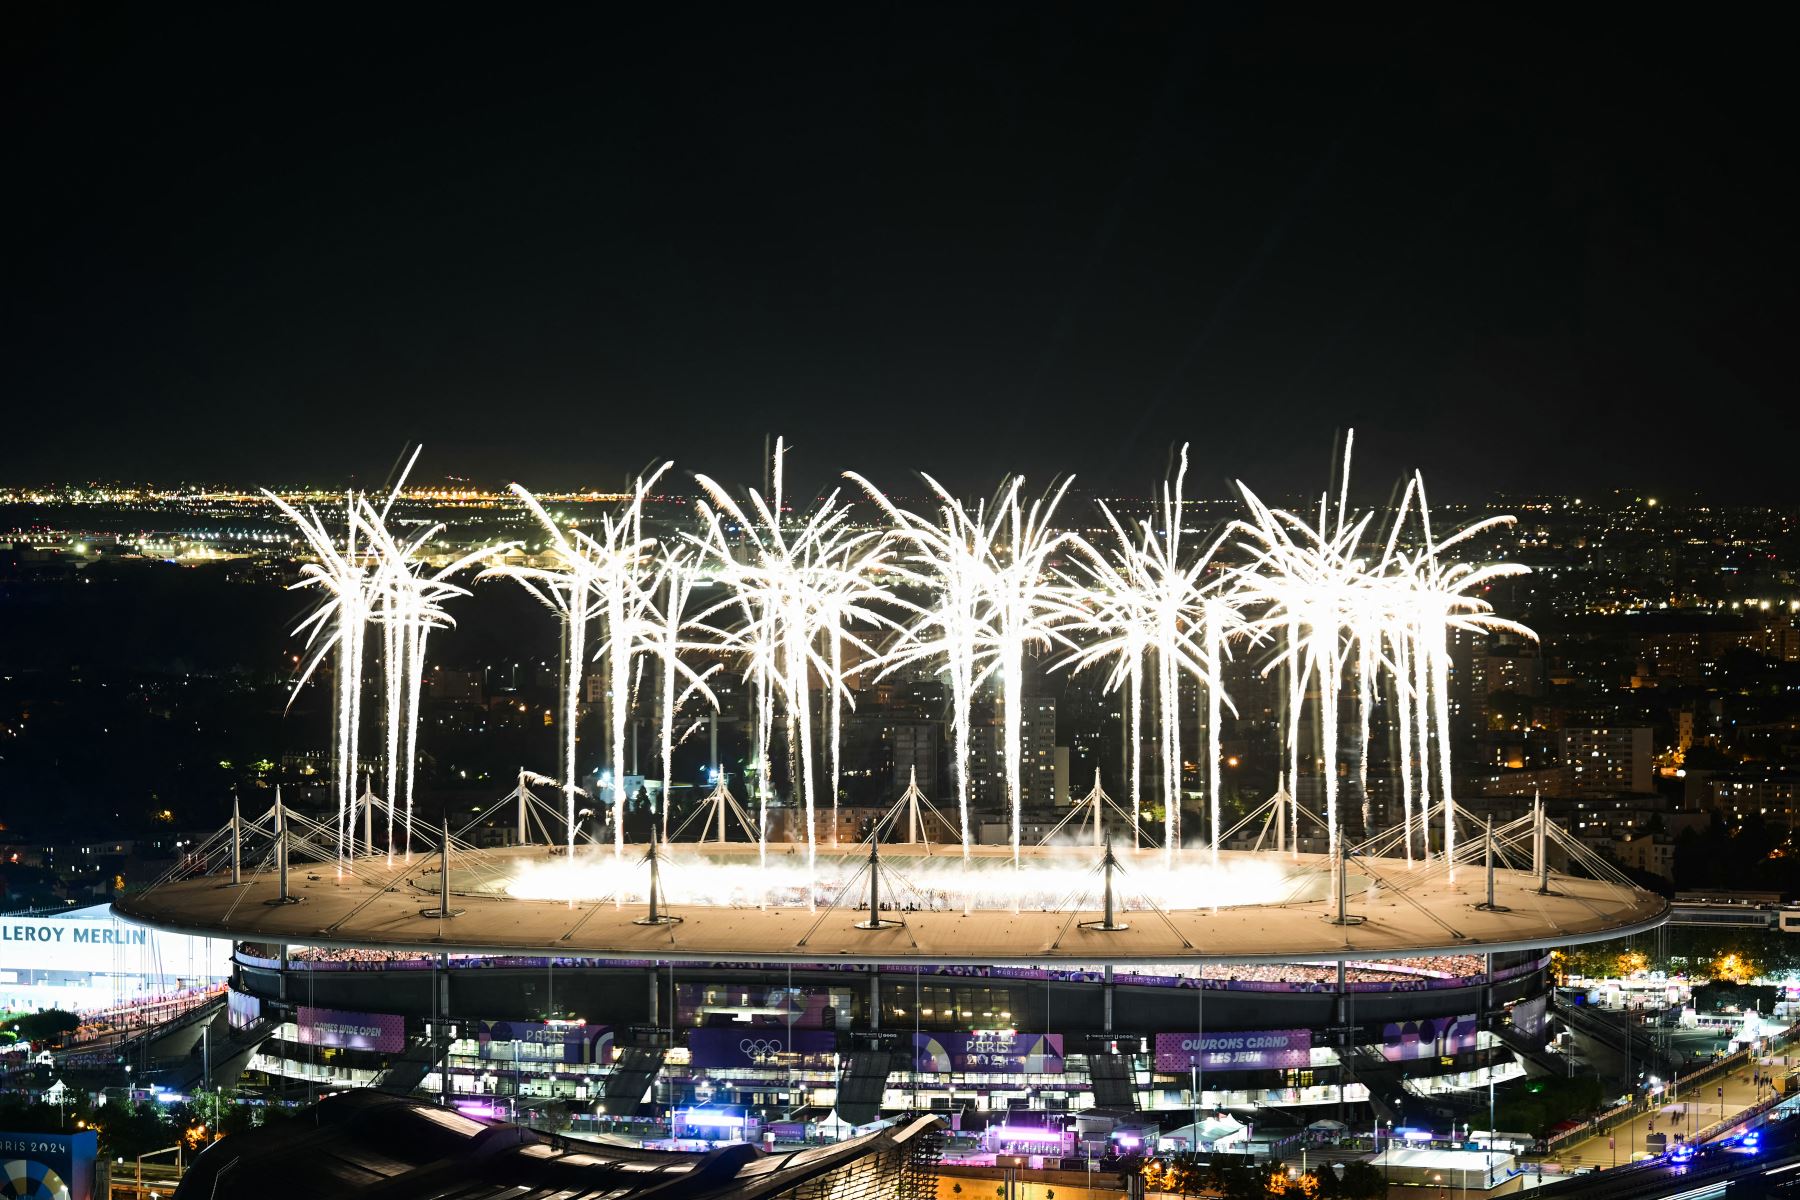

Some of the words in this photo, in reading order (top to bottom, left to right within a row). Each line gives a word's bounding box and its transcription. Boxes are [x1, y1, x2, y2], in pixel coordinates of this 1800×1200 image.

[2, 926, 65, 942] LEROY
[73, 928, 146, 945] MERLIN
[313, 1021, 338, 1033] GAMES
[338, 1024, 359, 1035] WIDE
[359, 1026, 381, 1037] OPEN
[526, 1029, 564, 1042] PARIS
[966, 1040, 1009, 1053] PARIS
[1181, 1037, 1244, 1051] OUVRONS
[1246, 1036, 1289, 1048] GRAND
[966, 1054, 1009, 1066] 2024
[1210, 1052, 1231, 1064] LES
[1232, 1051, 1262, 1063] JEUX
[30, 1142, 65, 1153] 2024
